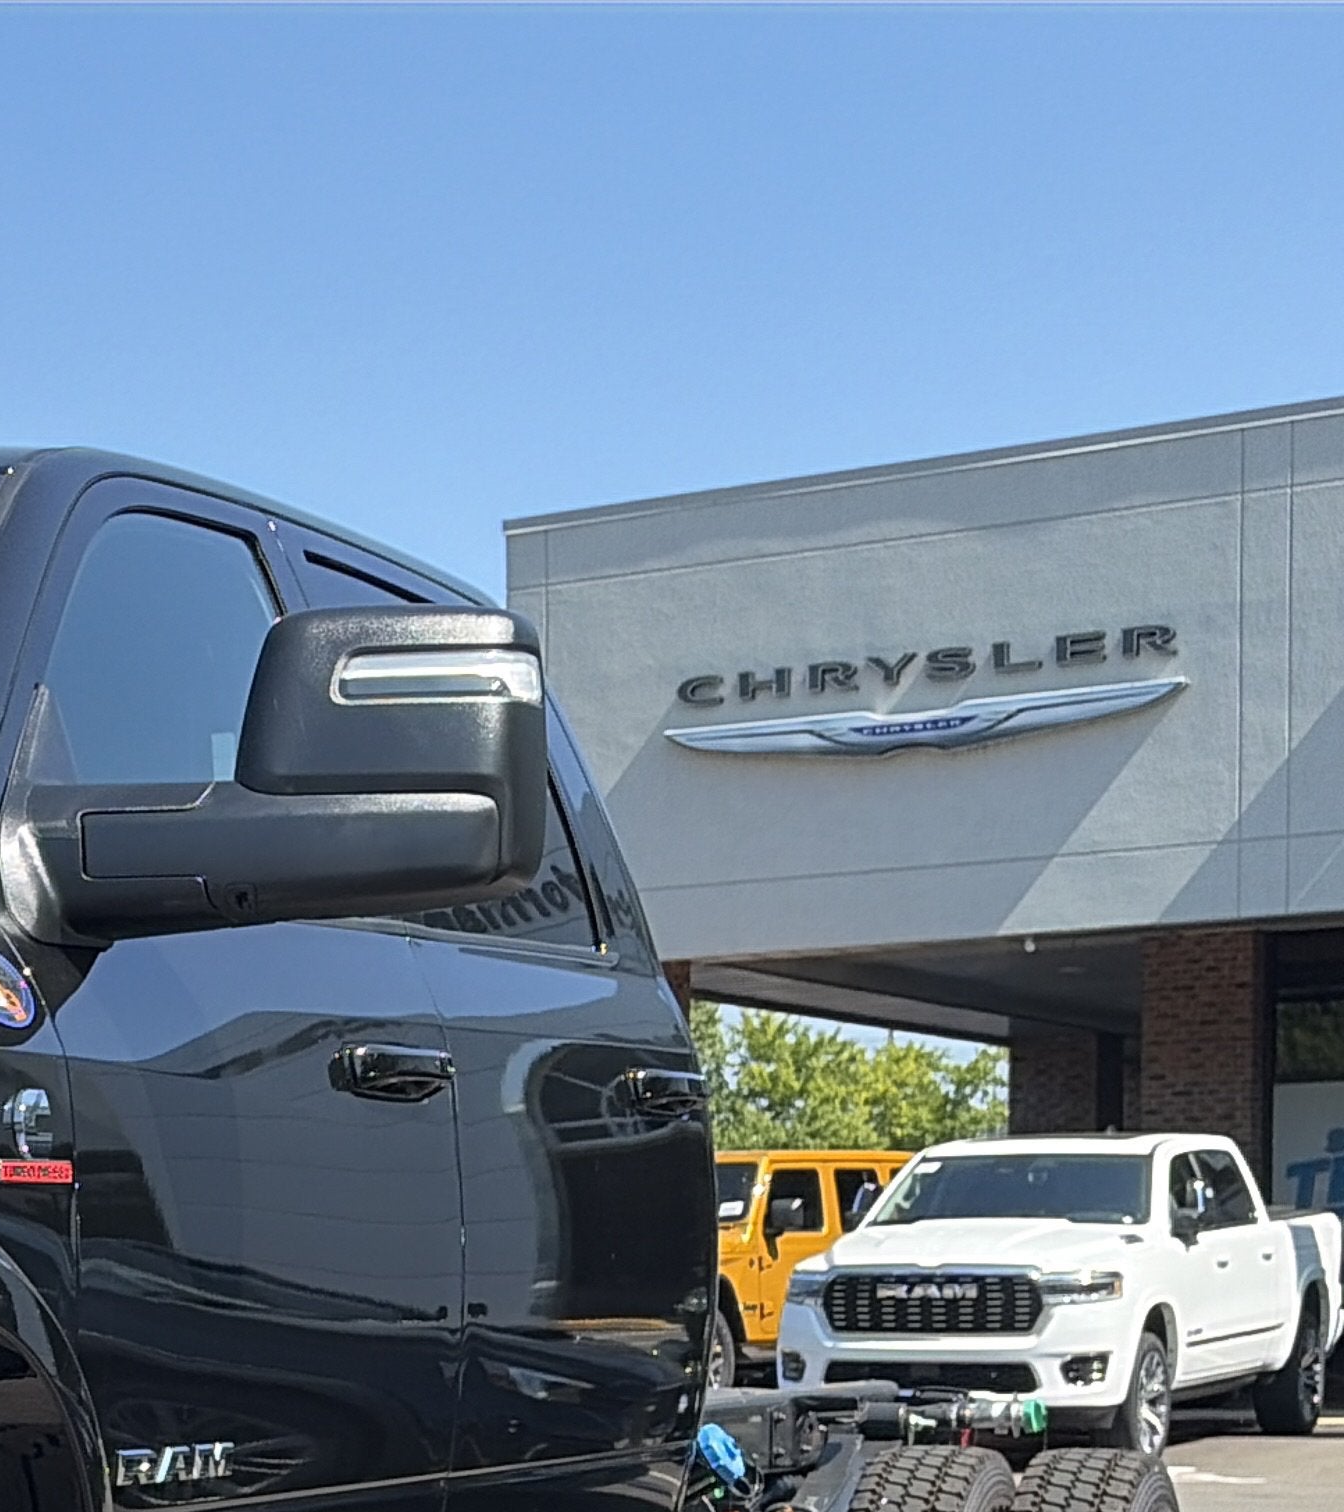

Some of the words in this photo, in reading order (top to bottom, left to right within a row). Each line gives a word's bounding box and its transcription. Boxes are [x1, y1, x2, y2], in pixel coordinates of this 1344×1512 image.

[676, 623, 1178, 708] CHRYSLER
[876, 1283, 978, 1299] RAM
[115, 1441, 235, 1487] RAM
